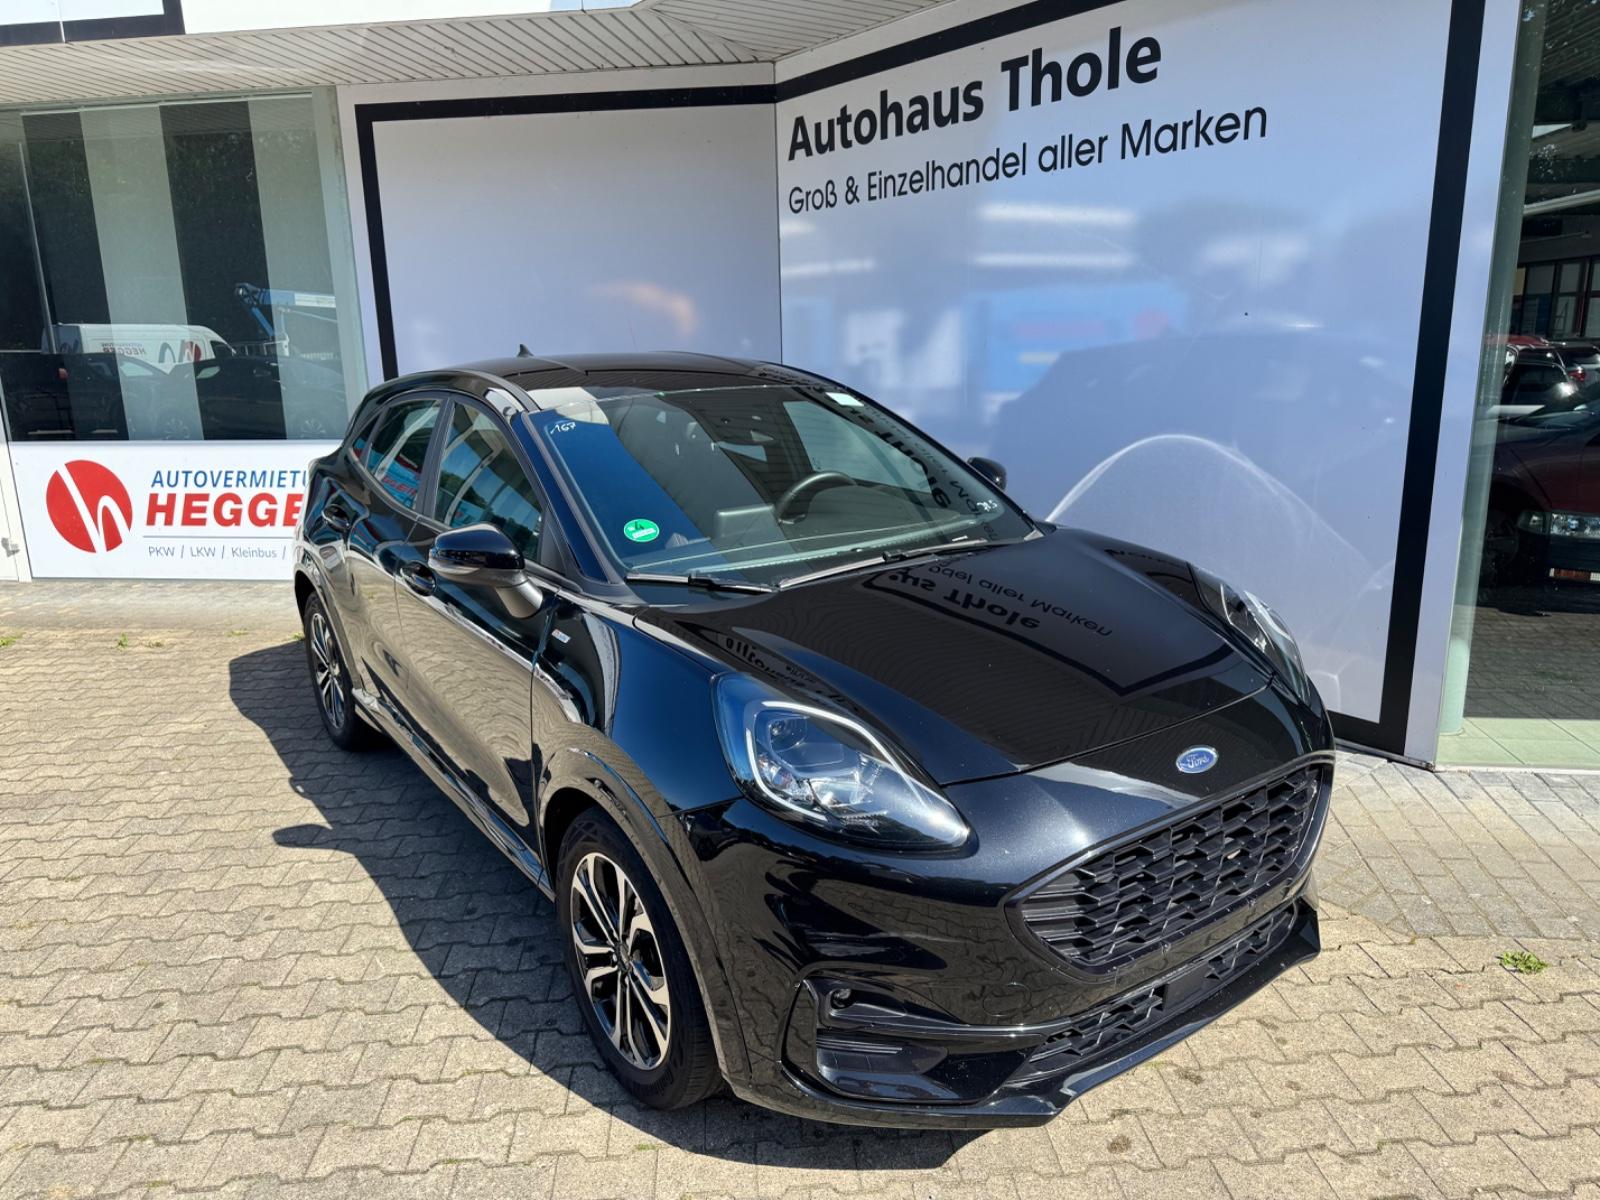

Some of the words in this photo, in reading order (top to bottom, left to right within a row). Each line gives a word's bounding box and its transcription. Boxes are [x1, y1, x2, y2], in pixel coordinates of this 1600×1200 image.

[788, 80, 984, 161] Autohaus
[1001, 26, 1161, 112] Thole
[789, 179, 838, 214] Groß
[845, 175, 860, 205] &
[867, 142, 1027, 201] Einzelhandel
[1038, 133, 1108, 172] aller
[1120, 106, 1267, 160] Marken
[151, 470, 306, 488] AUTOVERMIET
[148, 546, 175, 557] PKW
[190, 546, 216, 558] LKW
[231, 546, 278, 558] Kleinbus
